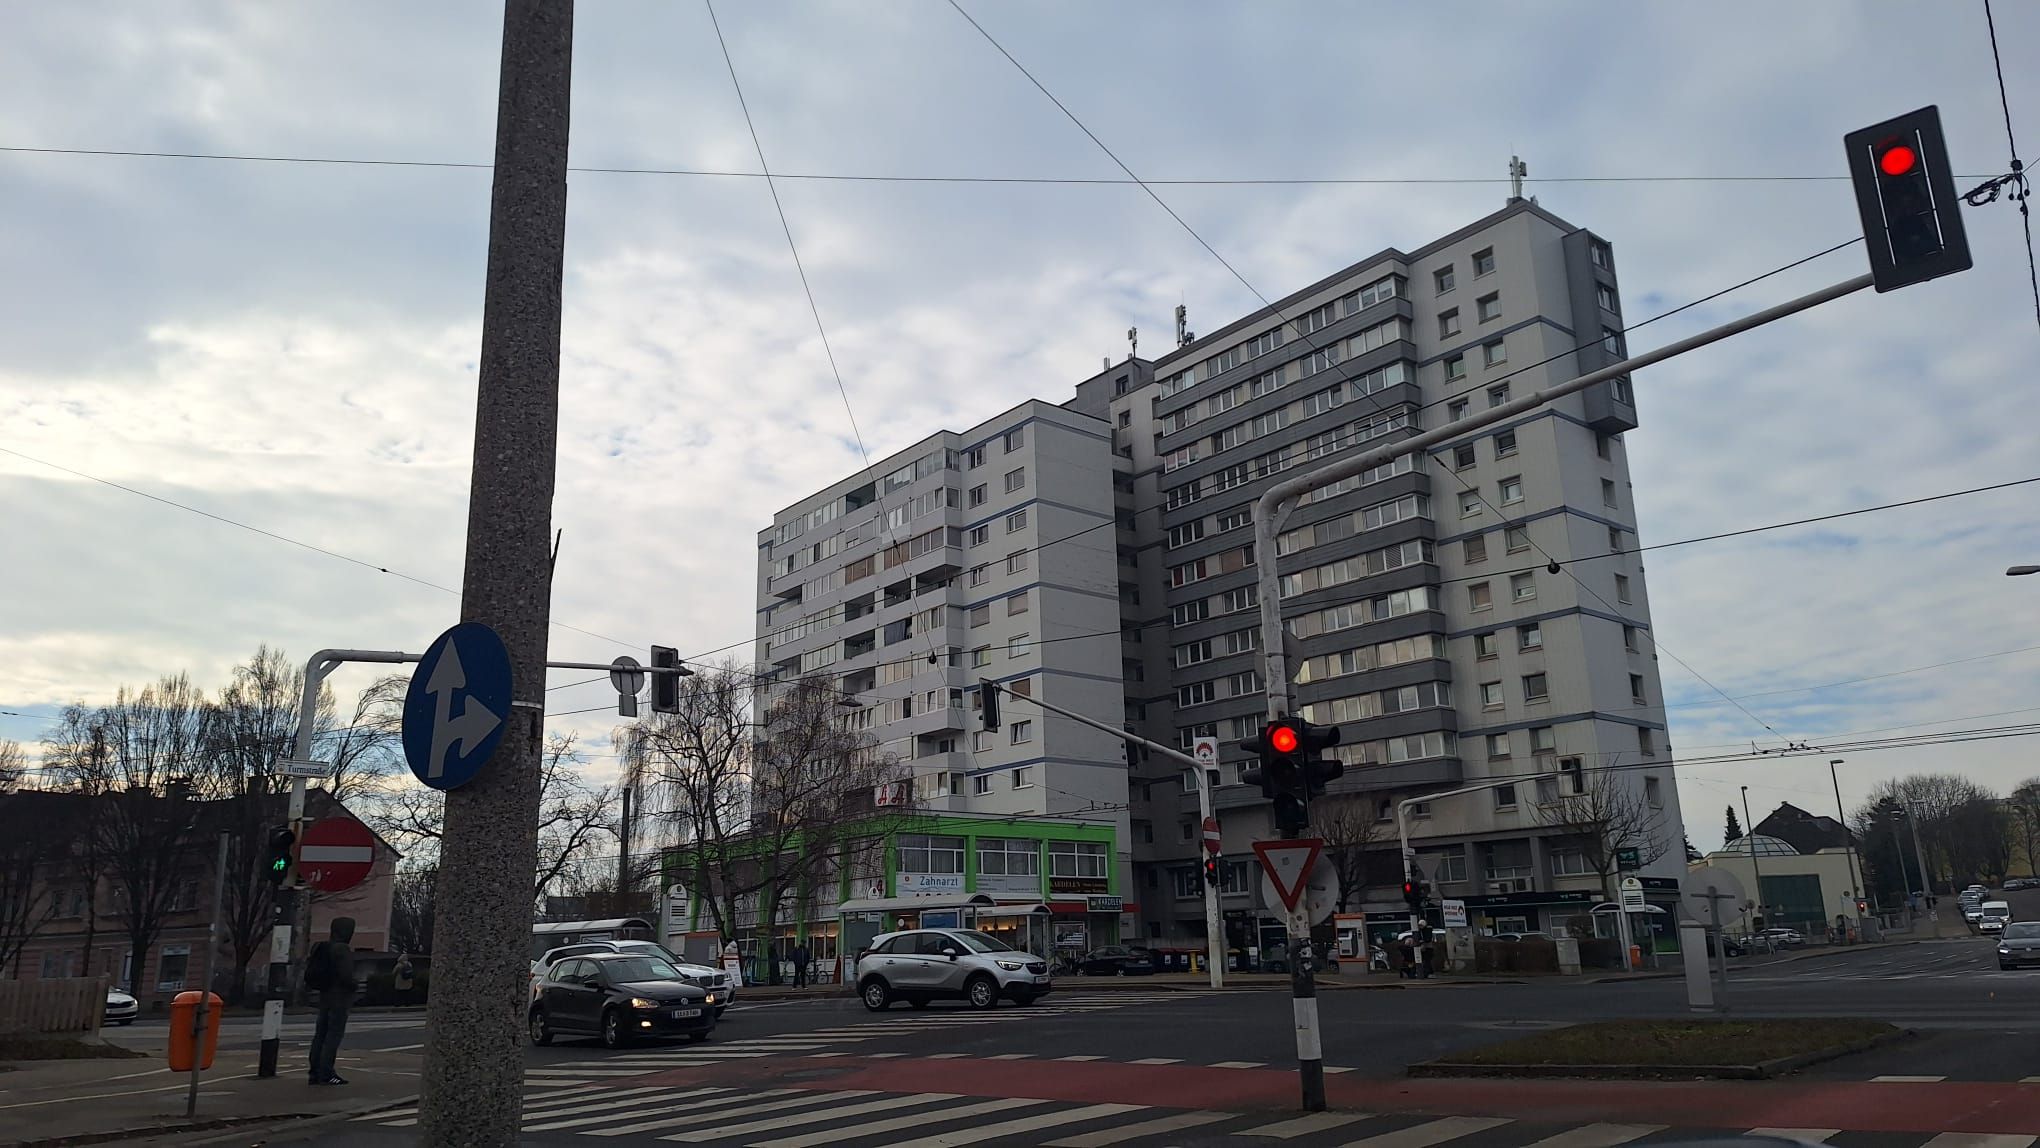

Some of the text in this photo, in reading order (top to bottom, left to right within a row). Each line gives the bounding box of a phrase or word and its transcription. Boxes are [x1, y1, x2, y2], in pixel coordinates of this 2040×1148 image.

[287, 765, 327, 775] Turmstraße
[919, 876, 958, 886] Zahnarzt
[1098, 898, 1121, 906] KARDELEN
